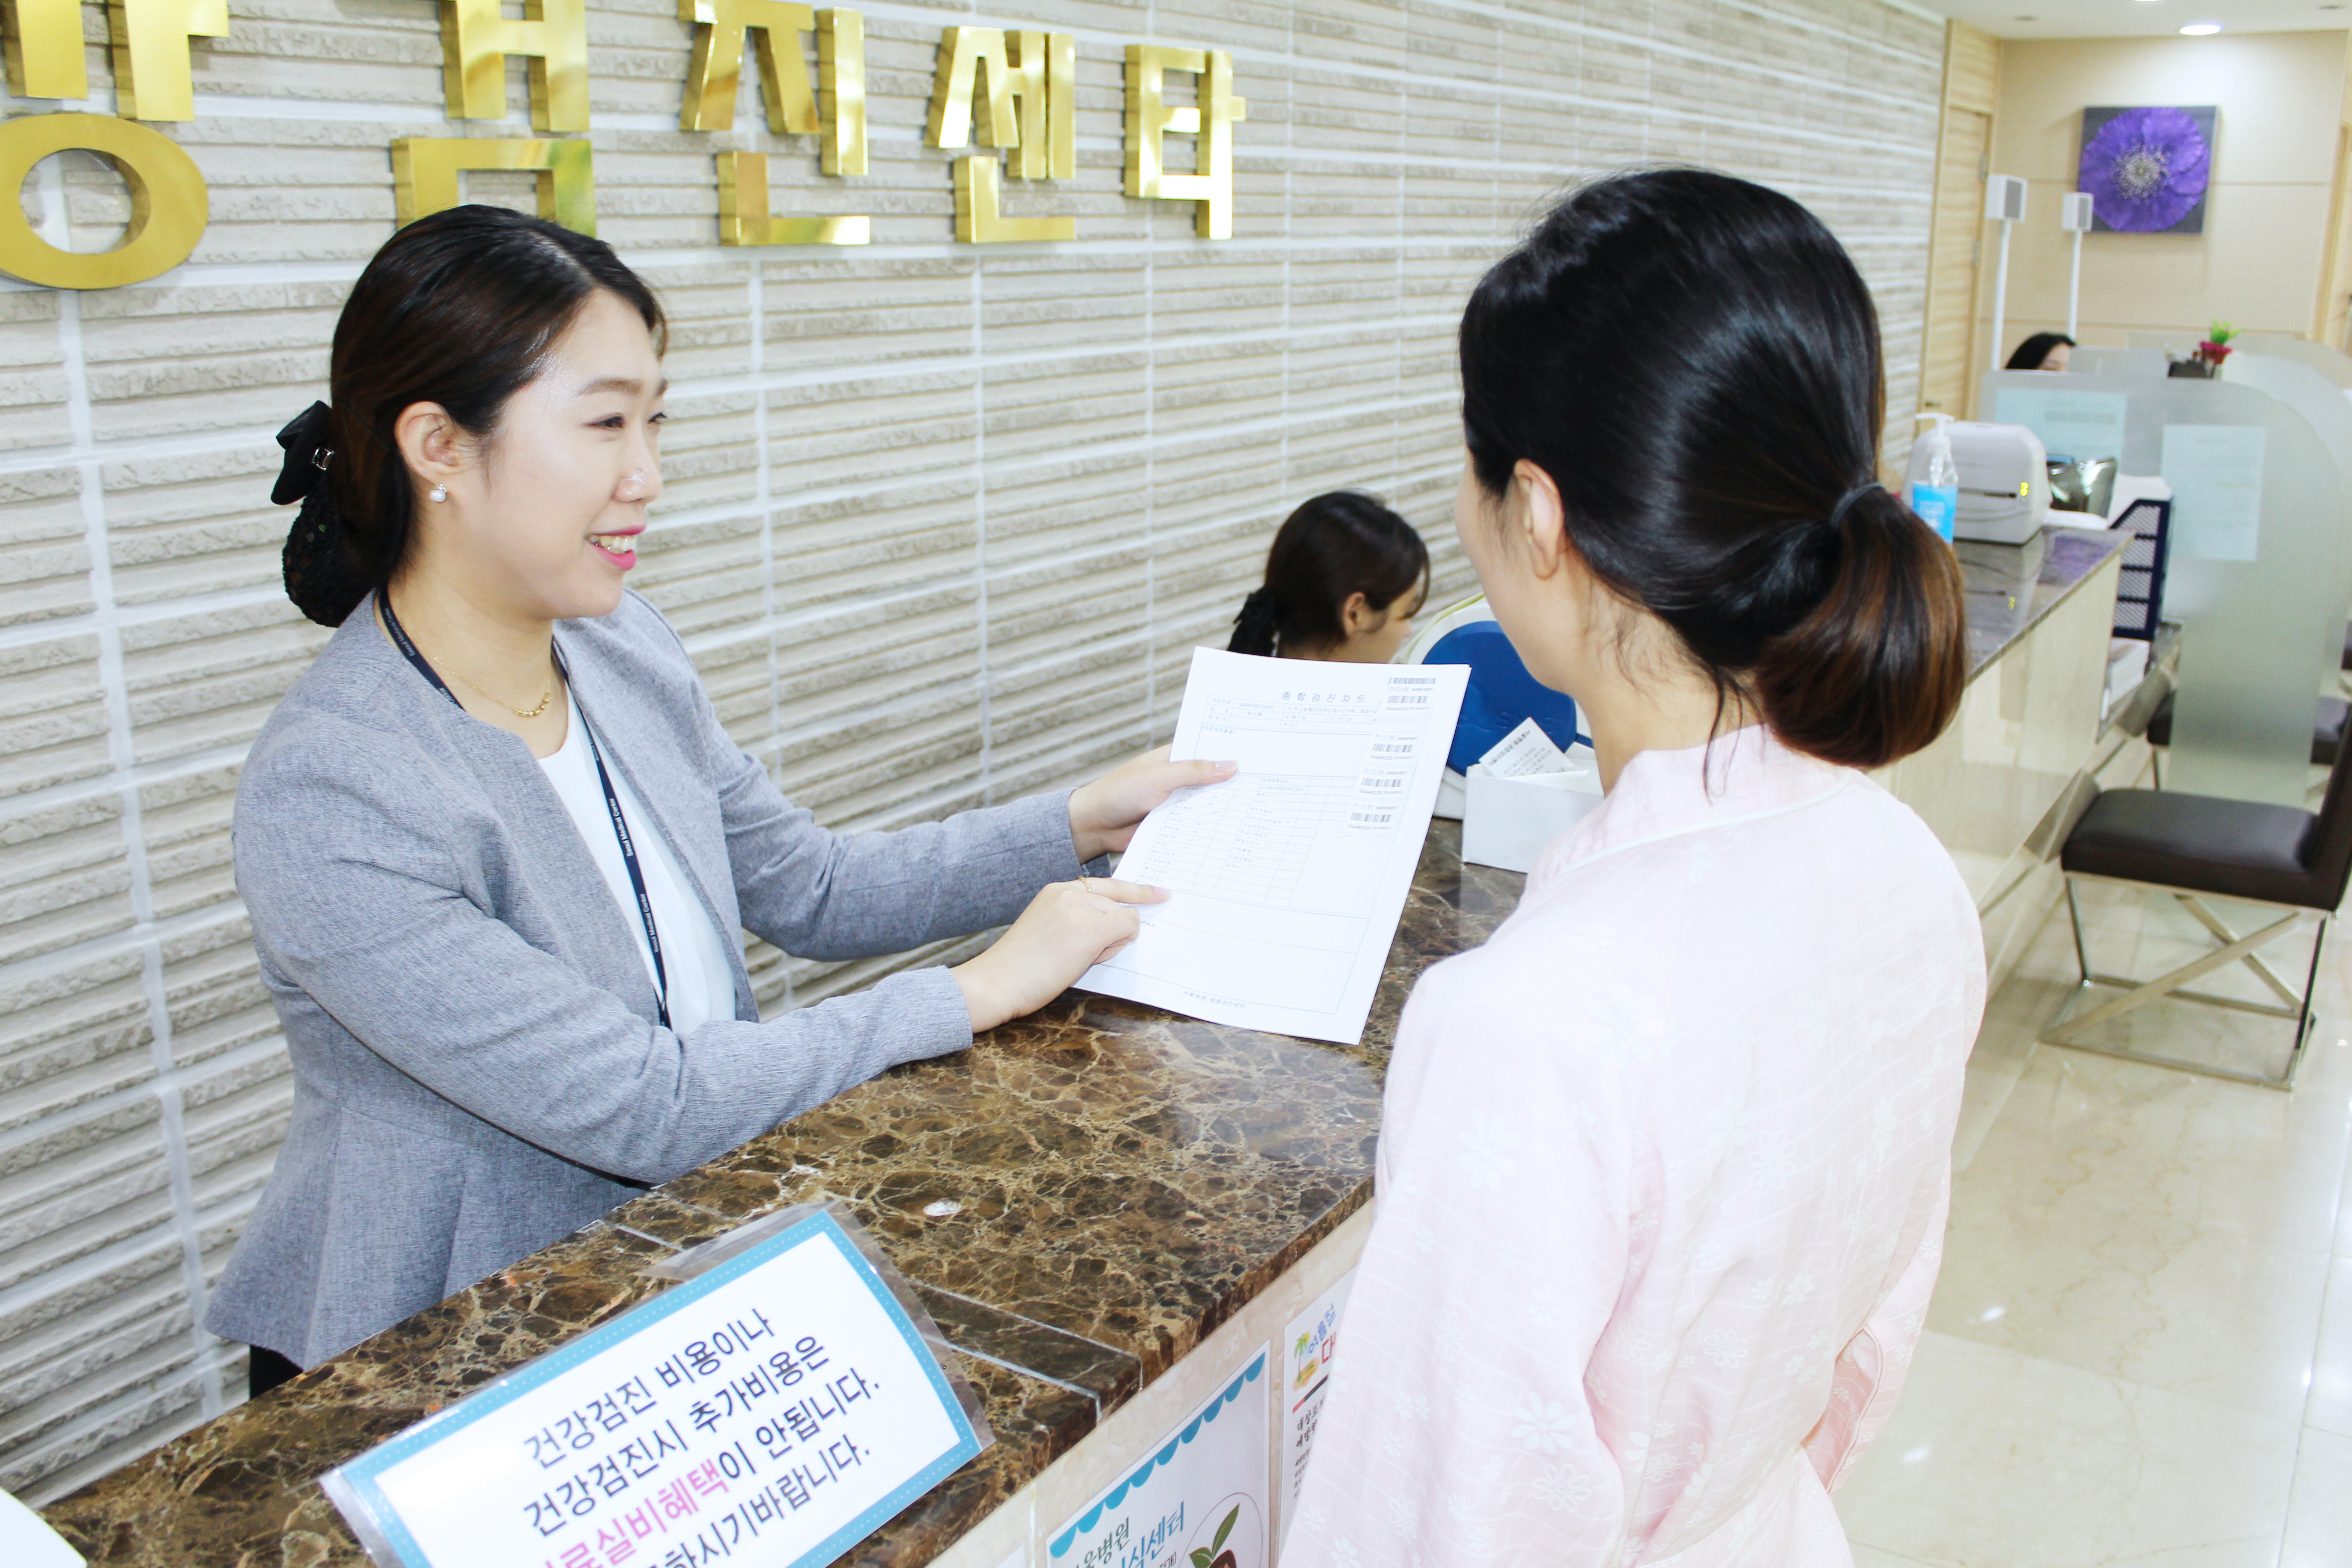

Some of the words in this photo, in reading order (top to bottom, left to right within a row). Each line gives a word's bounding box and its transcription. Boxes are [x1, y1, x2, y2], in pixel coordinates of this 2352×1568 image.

[609, 798, 620, 817] Center
[615, 817, 628, 840] Medical
[623, 840, 634, 857] Seoul
[524, 1375, 657, 1469] 건강검진
[655, 1308, 775, 1388] 비용이나
[524, 1419, 688, 1537] 건강검진시
[689, 1336, 830, 1433] 추가비용은
[546, 1441, 756, 1568] 료실비혜택이
[755, 1367, 880, 1460] 안됩니다.
[649, 1434, 871, 1568] 하시기바랍니다.
[1076, 1515, 1130, 1568] 울병원
